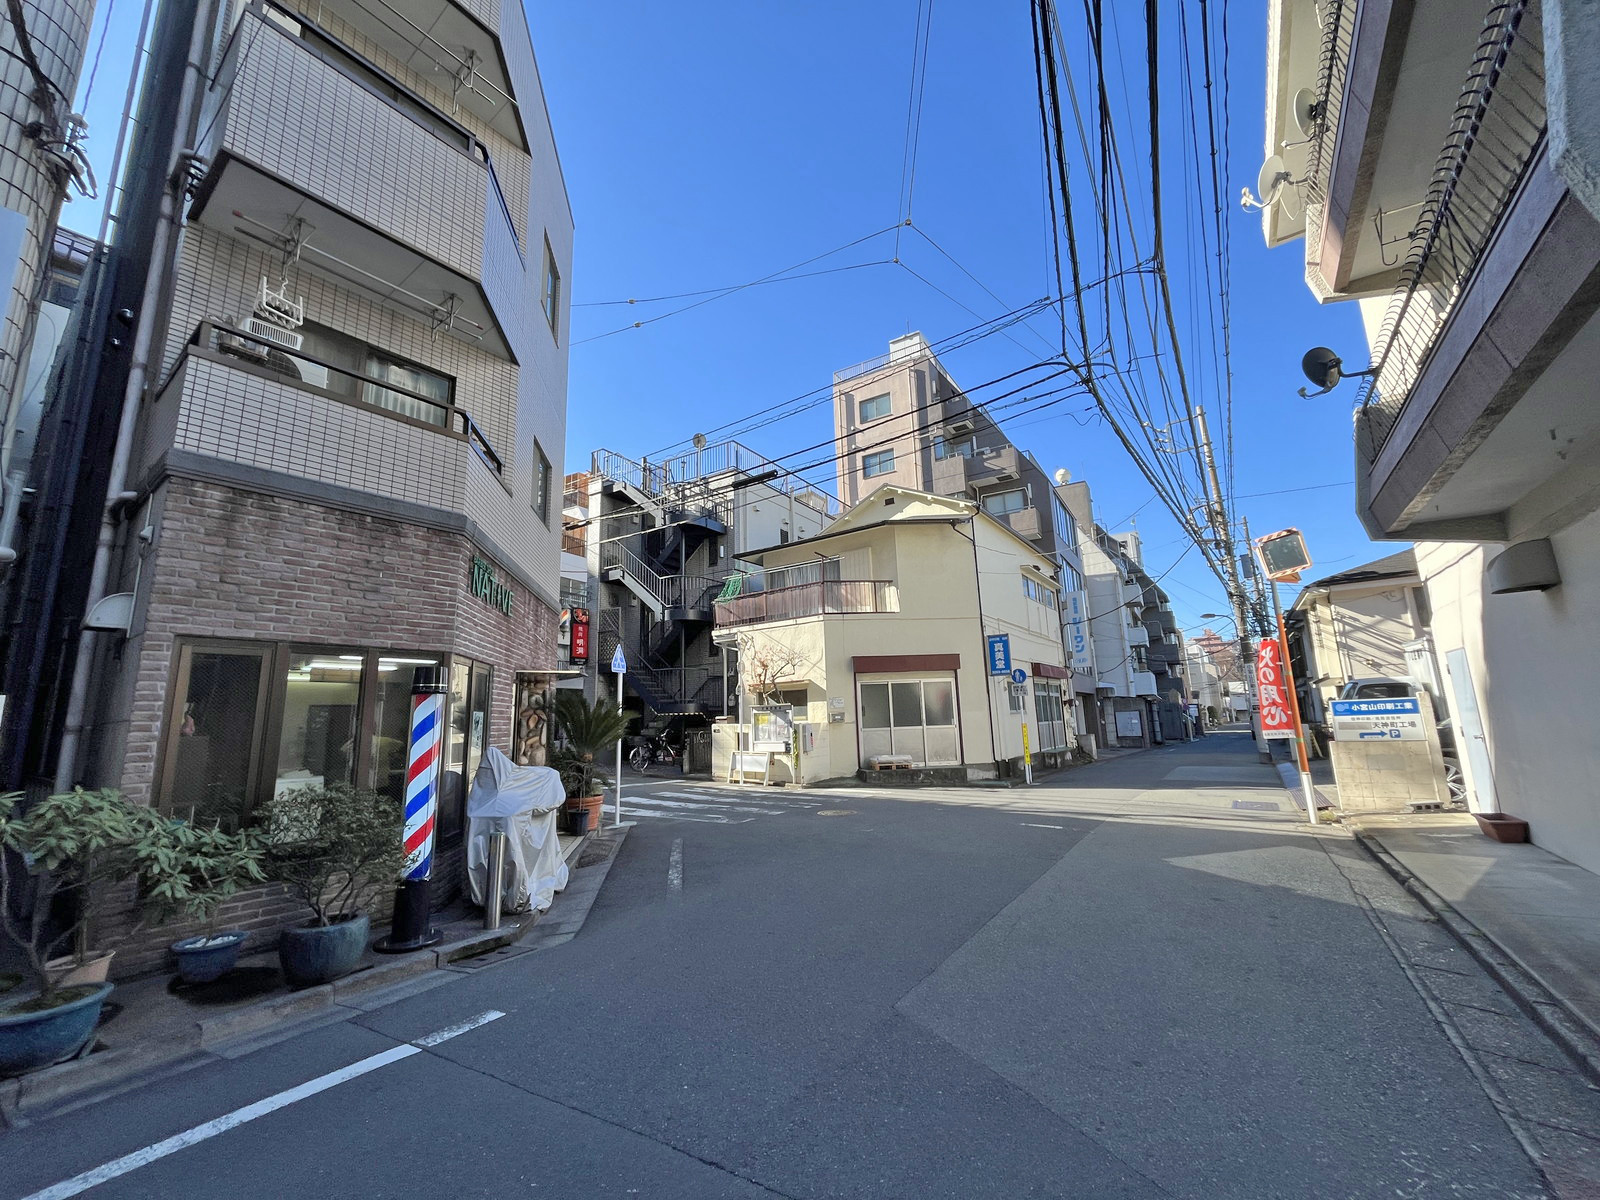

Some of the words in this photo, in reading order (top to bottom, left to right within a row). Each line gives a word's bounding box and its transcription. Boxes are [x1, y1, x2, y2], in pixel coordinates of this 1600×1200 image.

[473, 564, 514, 617] NATIVE
[1260, 646, 1288, 726] 火の用心
[1351, 702, 1414, 712] 小宮山印刷工業
[1373, 721, 1416, 729] 天神町工場
